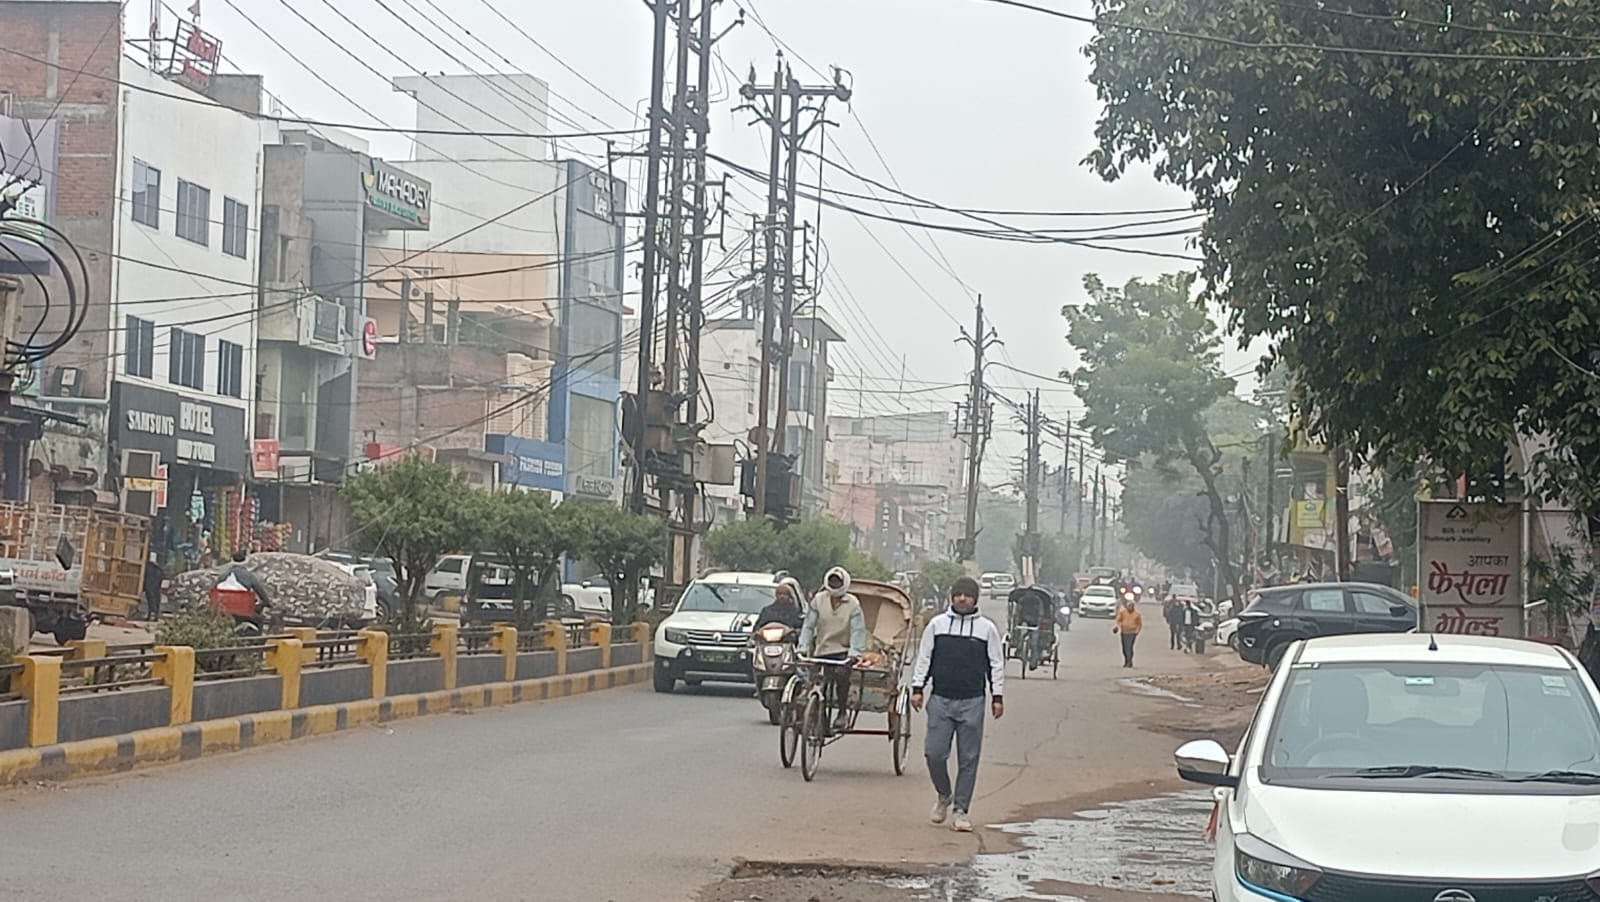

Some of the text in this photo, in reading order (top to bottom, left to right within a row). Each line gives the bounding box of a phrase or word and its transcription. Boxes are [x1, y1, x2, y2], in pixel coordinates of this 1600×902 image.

[127, 409, 175, 437] SAMSUNG
[180, 401, 215, 435] HOTEL
[1467, 555, 1509, 567] आपका
